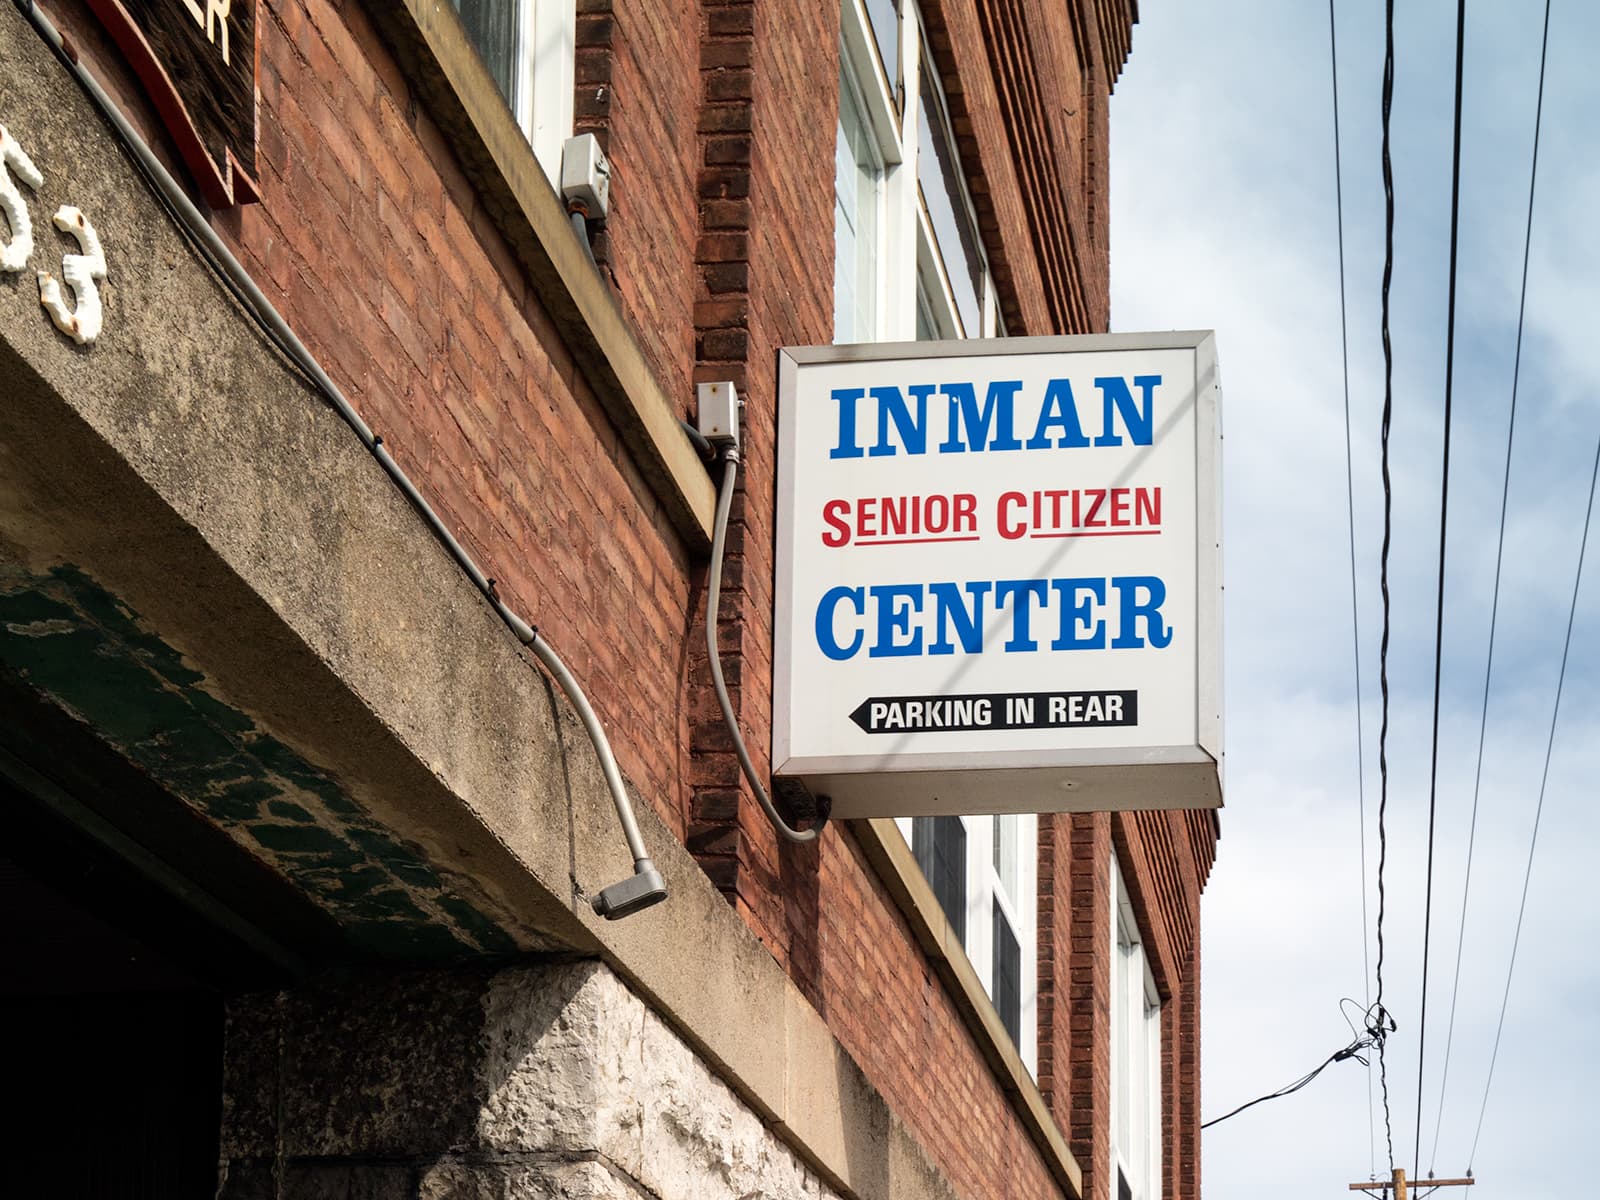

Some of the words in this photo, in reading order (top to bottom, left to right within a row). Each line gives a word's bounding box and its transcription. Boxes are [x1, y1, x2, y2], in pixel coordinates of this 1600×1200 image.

[830, 375, 1162, 459] INMAN
[822, 494, 978, 547] SENIOR
[997, 487, 1161, 539] CITIZEN
[815, 576, 1173, 660] CENTER
[870, 698, 992, 729] PARKING
[1006, 697, 1034, 724] IN
[1049, 695, 1123, 723] REAR
